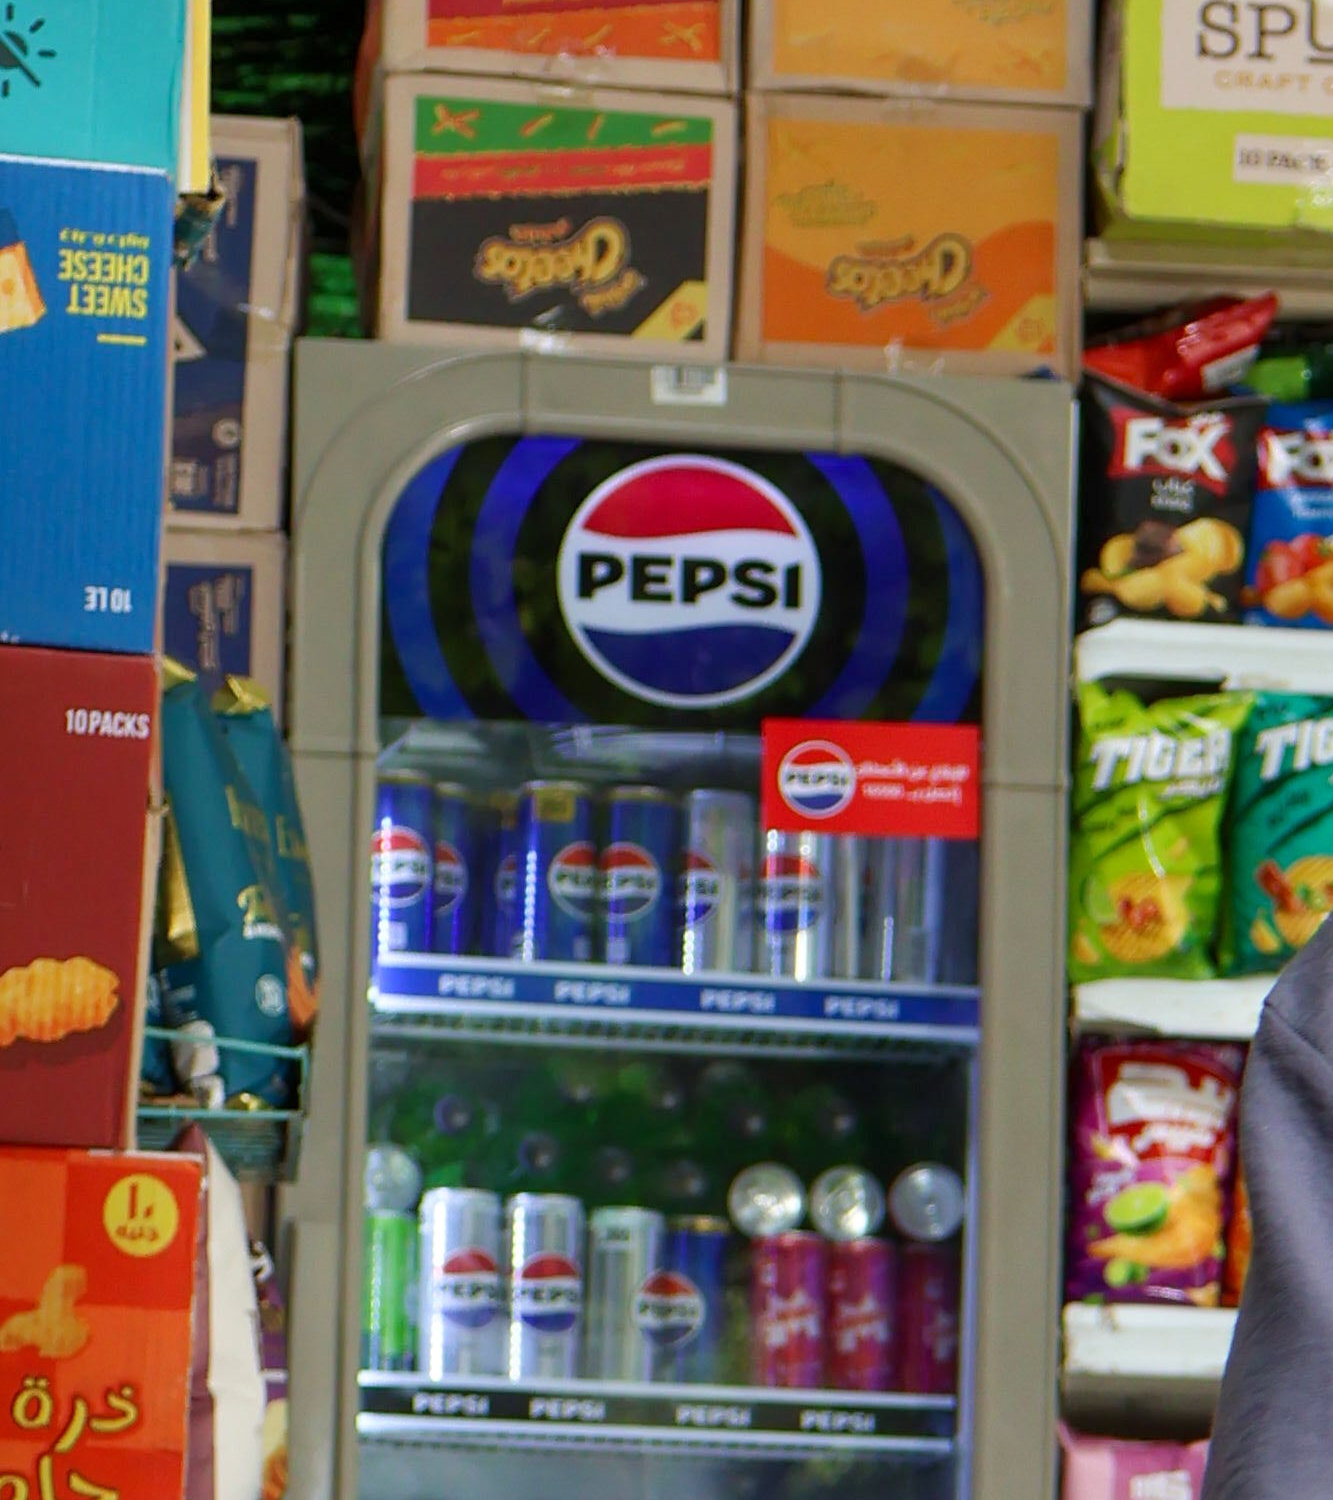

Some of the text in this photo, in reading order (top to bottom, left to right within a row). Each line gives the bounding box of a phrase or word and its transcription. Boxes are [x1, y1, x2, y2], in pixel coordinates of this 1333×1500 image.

[1212, 67, 1311, 96] CRAFT
[57, 247, 151, 284] CHEESE
[474, 217, 629, 300] Cheetos
[826, 233, 971, 309] Cheetos
[66, 285, 149, 319] SWEET
[1122, 415, 1232, 483] FOX
[83, 585, 133, 613] 10 LE
[575, 552, 802, 610] PEPSI
[785, 770, 851, 790] PEPSI
[1090, 729, 1232, 792] TIGER
[439, 972, 899, 1019] PEPSI PEPSI PEPSI PEPSI
[11, 1376, 140, 1454] ذرة
[411, 1392, 877, 1433] PEPSI PEPSI PEPSI PEPSI
